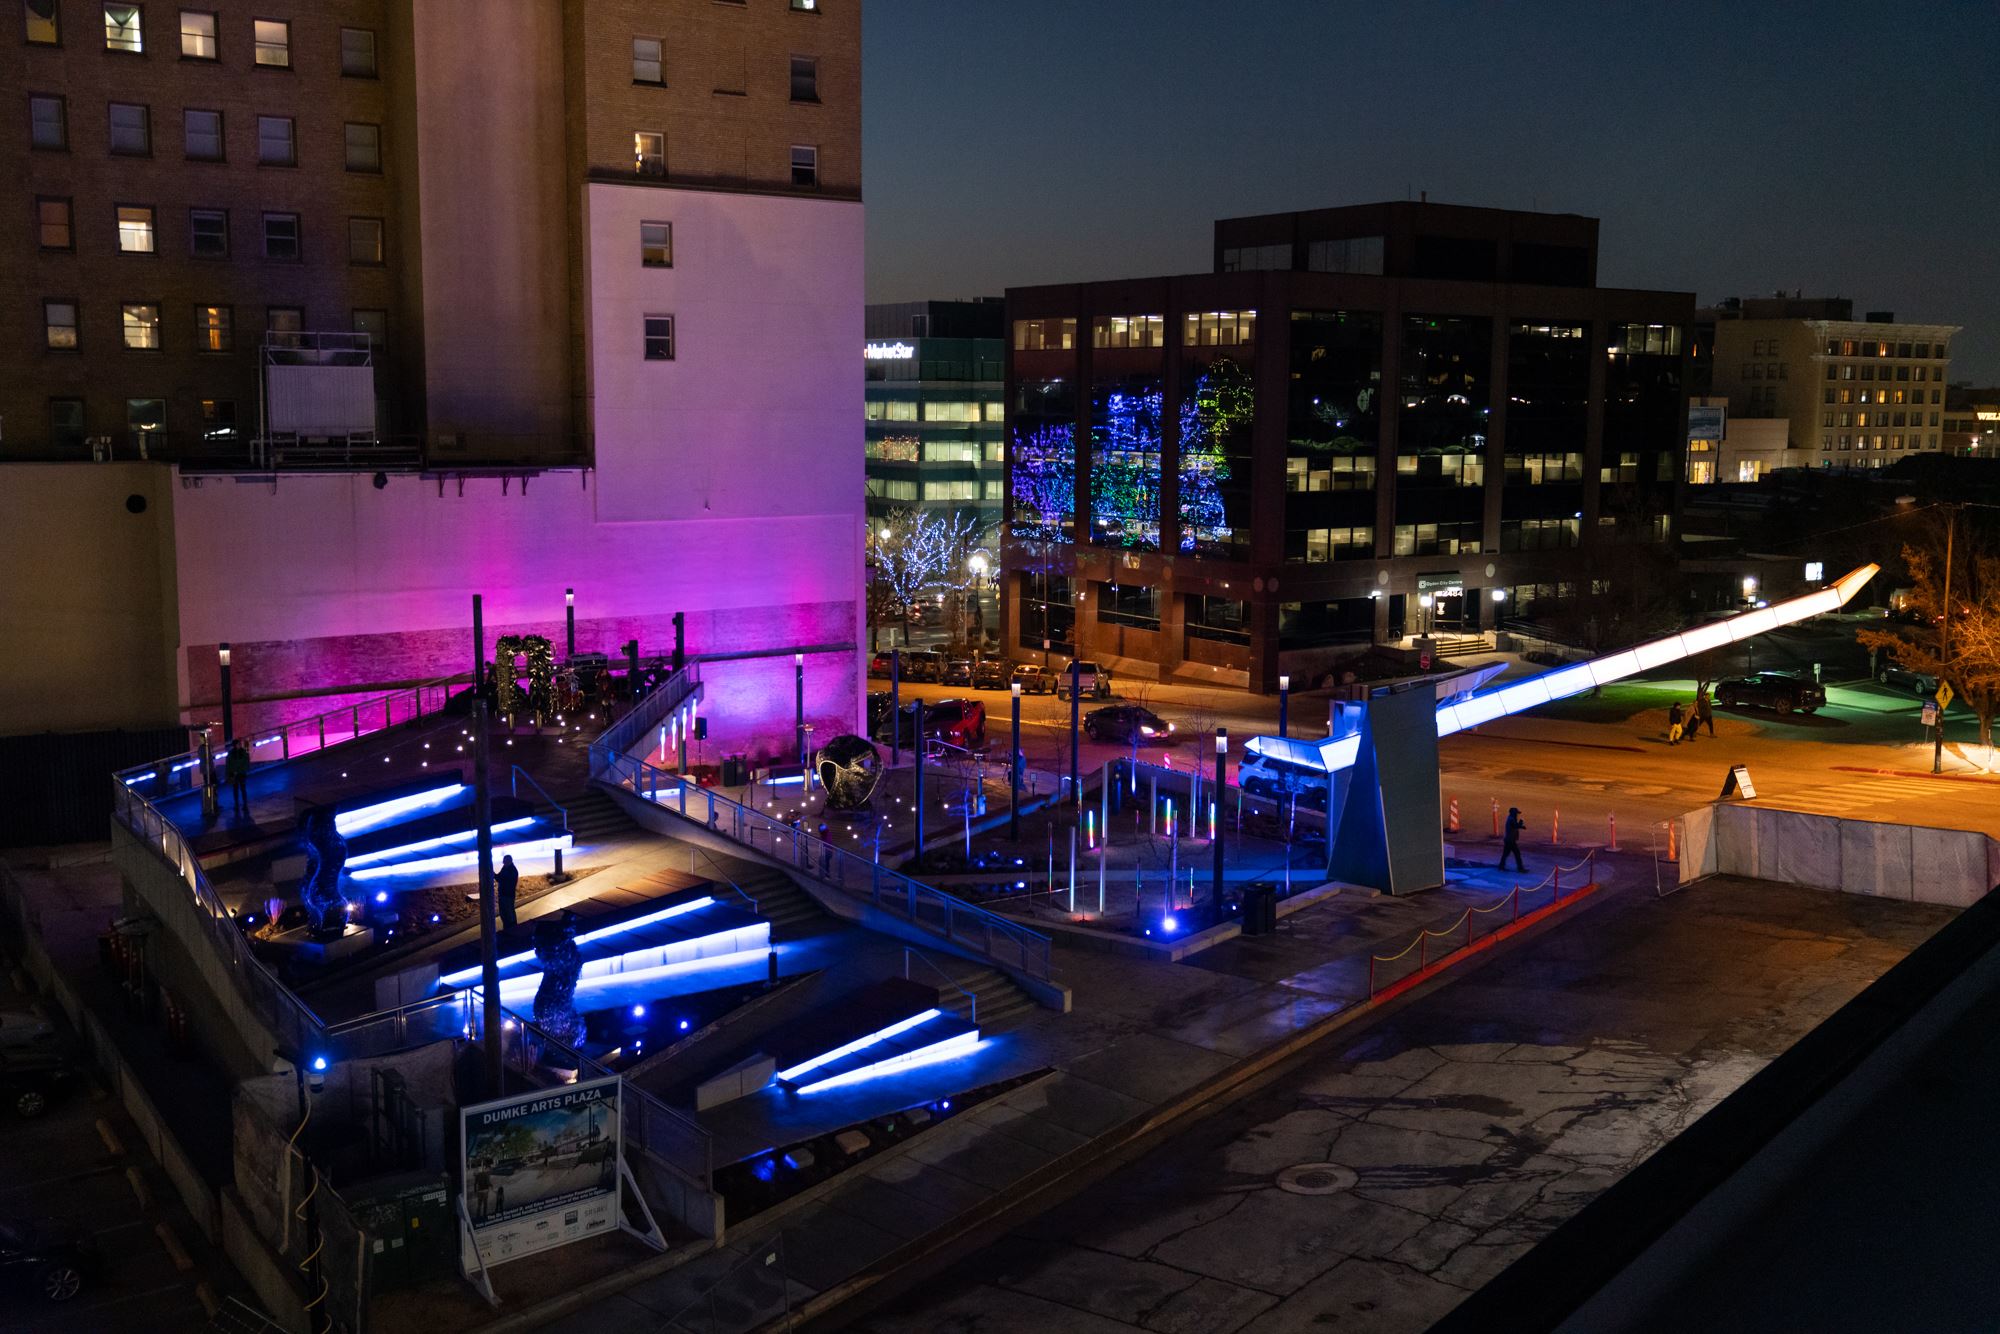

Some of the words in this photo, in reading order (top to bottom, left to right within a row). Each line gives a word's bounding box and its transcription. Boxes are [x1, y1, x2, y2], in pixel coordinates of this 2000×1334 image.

[868, 342, 914, 359] MarketStar
[483, 1106, 529, 1125] DUMKE
[531, 1098, 562, 1114] ARTS
[565, 1089, 602, 1106] PLAZA
